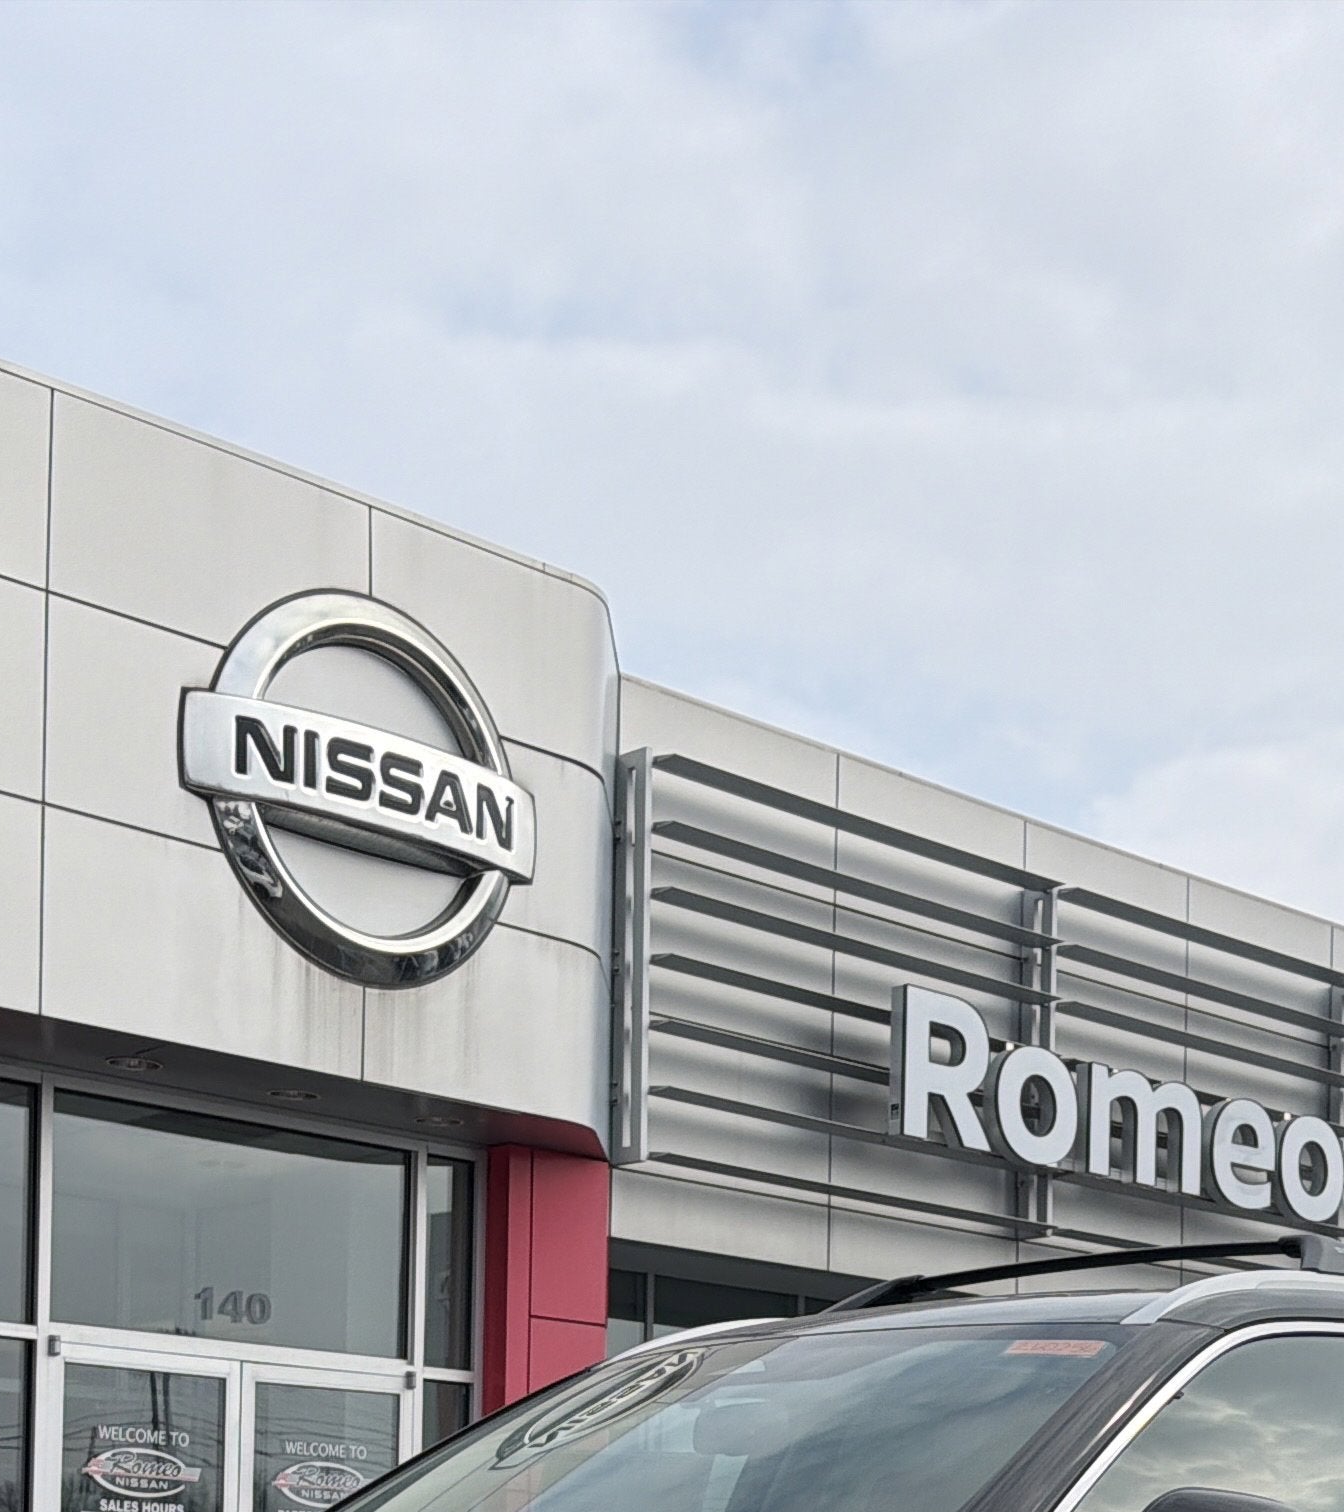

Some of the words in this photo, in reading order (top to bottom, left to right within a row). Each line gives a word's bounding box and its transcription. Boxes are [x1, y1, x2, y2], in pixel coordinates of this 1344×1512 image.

[234, 714, 515, 852] NISSAN
[892, 983, 1344, 1222] Romeo
[194, 1286, 272, 1325] 140
[97, 1425, 167, 1446] WELCOME
[170, 1431, 190, 1447] TO
[284, 1440, 347, 1457] WELCOME
[349, 1445, 367, 1460] TO
[108, 1451, 182, 1478] Romeo
[292, 1465, 361, 1488] Romeo
[114, 1475, 169, 1491] NISSAN
